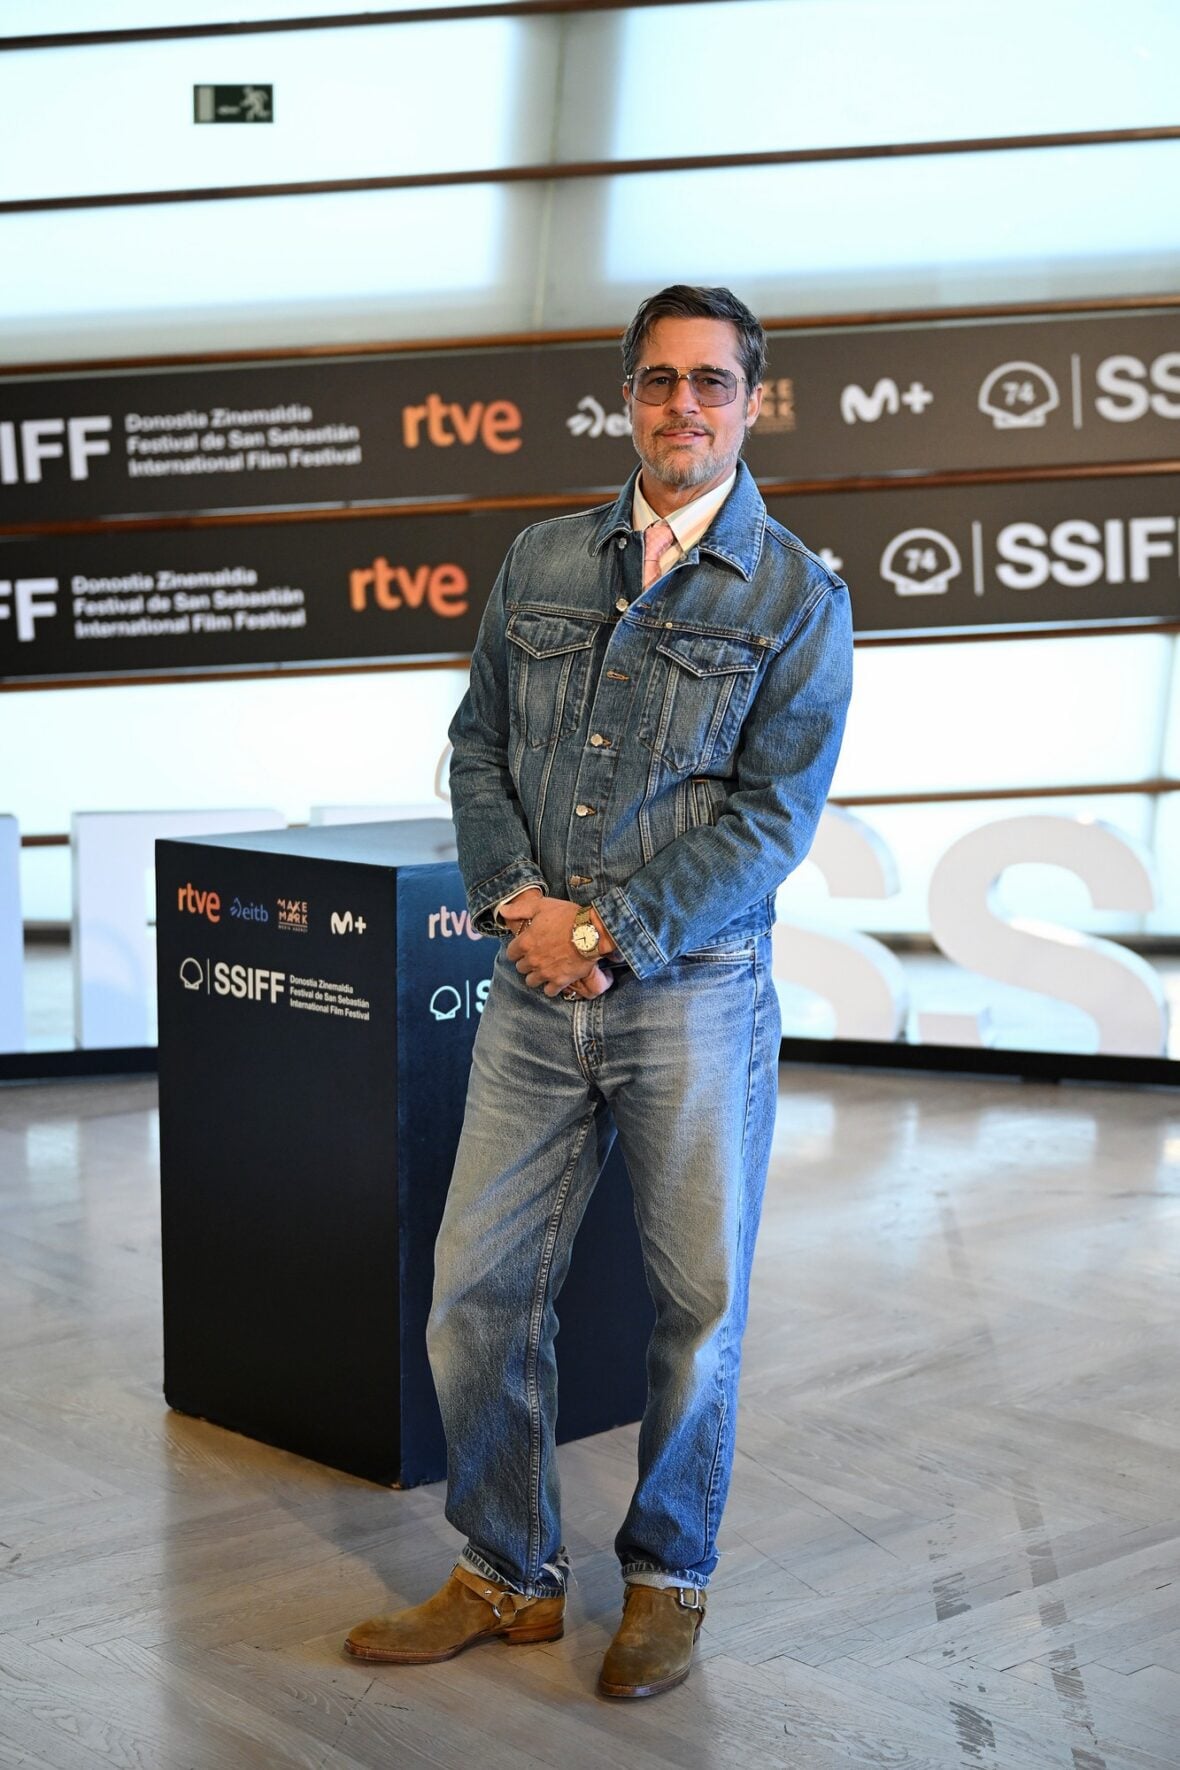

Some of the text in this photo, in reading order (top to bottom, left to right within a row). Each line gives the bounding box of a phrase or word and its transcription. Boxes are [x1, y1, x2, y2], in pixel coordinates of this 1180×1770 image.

[1003, 381, 1035, 405] 74
[125, 403, 312, 433] Donostia Zinemaldia
[403, 394, 522, 453] rtve
[126, 423, 360, 455] Festival de San Sebastián
[128, 445, 362, 477] International Film Festival
[904, 548, 939, 573] 74
[996, 517, 1180, 589] SSIF
[72, 566, 258, 595] Donostia Zinemaldia
[350, 557, 469, 618] rtve
[73, 586, 305, 617] Festival de San Sebastián
[74, 608, 306, 639] International Film Festival
[178, 883, 221, 923] rtve
[242, 902, 269, 922] eitb
[277, 898, 308, 913] MAKE
[278, 911, 308, 924] MARK
[214, 962, 286, 1004] SSIFF
[290, 974, 354, 994] Donostia Zinemaldia
[290, 986, 370, 1008] Festival de San Sebastián
[290, 998, 370, 1020] International Film Festival
